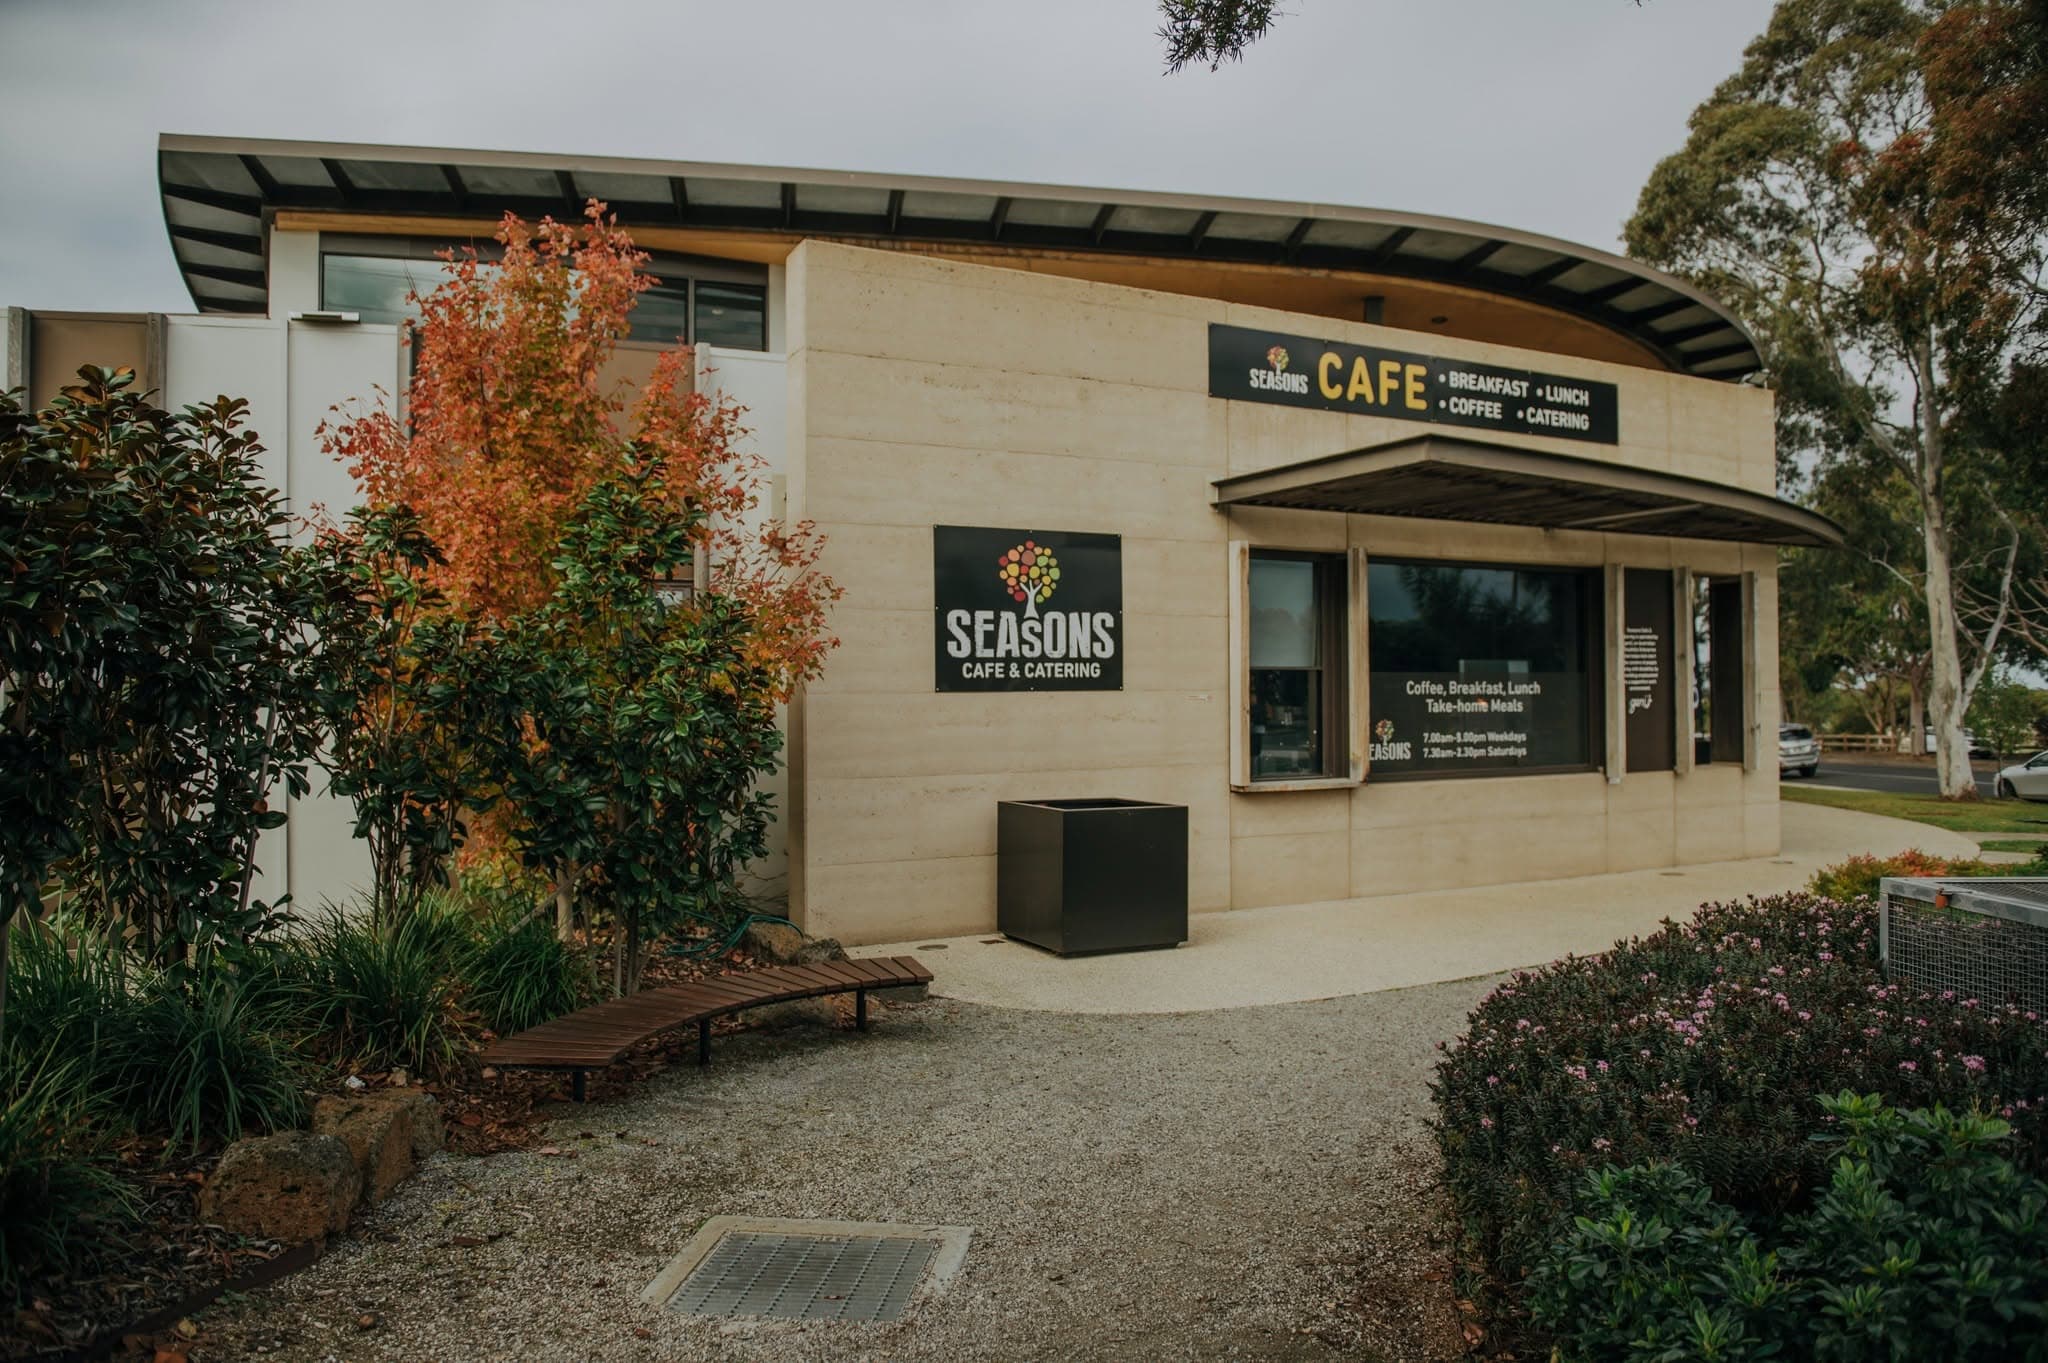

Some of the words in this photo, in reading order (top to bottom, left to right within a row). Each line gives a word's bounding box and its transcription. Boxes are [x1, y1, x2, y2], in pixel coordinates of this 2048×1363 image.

[1249, 367, 1308, 394] SEASONS
[1318, 351, 1429, 411] CAFE
[1449, 371, 1529, 397] BREAKFAST
[1546, 384, 1590, 407] LUNCH
[1449, 396, 1503, 420] COFFEE
[1526, 407, 1590, 431] CATERING
[947, 609, 1115, 659] SEASONS
[962, 662, 1005, 678] CAFE
[1009, 662, 1020, 678] &
[1024, 662, 1101, 678] CATERING
[1406, 680, 1447, 696] Coffee,
[1449, 680, 1507, 696] Breakfast,
[1508, 681, 1541, 695] Lunch
[1425, 698, 1488, 713] Take-home
[1490, 698, 1524, 713] Meals
[1487, 731, 1527, 744] Weekdays
[1369, 742, 1412, 761] EASONS
[1487, 746, 1528, 759] Saturdays
